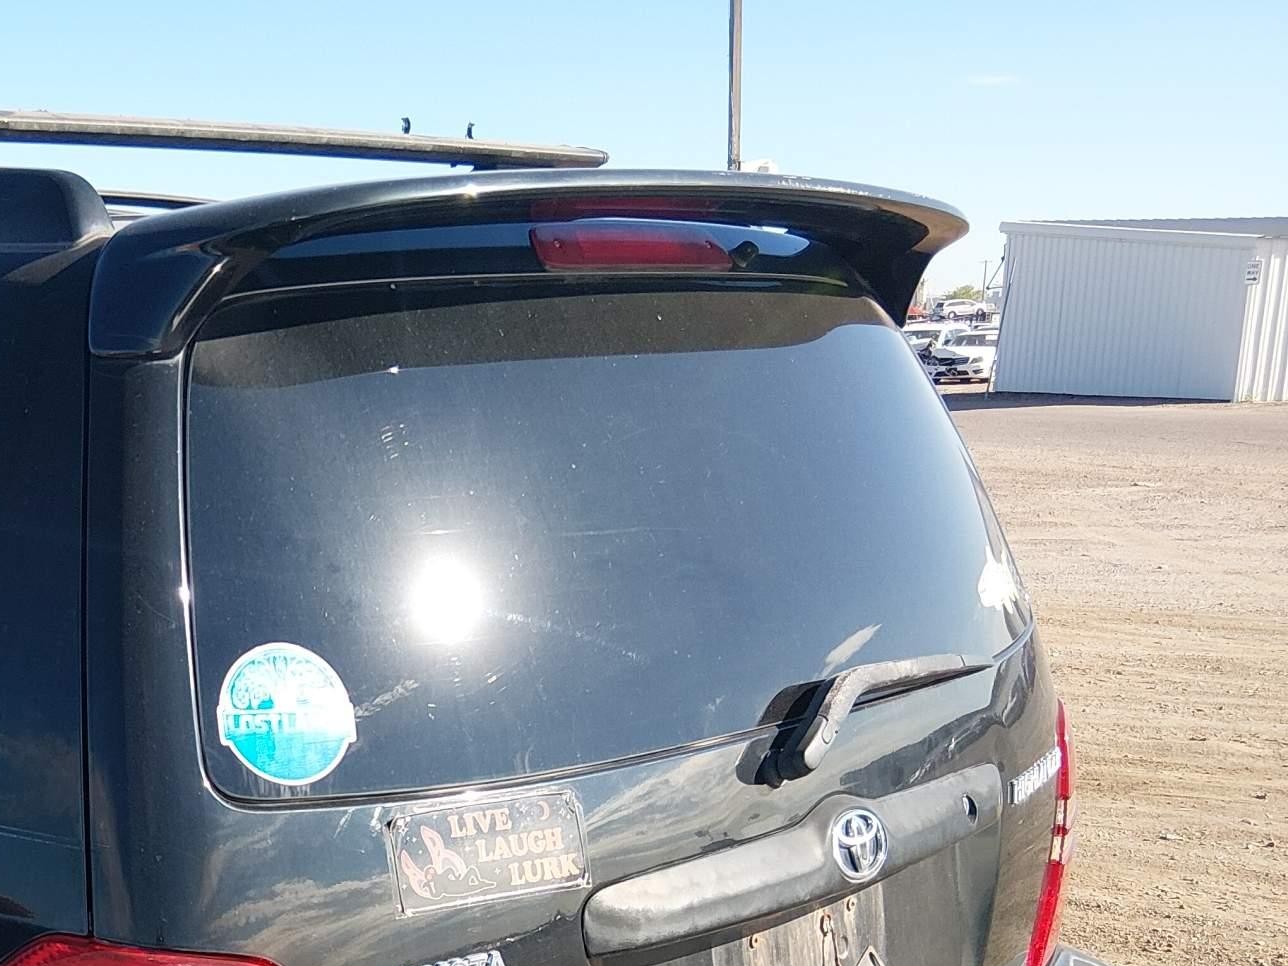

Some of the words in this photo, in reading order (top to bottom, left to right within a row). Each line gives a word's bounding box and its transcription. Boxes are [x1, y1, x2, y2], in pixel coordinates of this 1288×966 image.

[447, 807, 513, 838] LIVE
[475, 827, 564, 863] LAUGH
[508, 852, 580, 886] LURK
